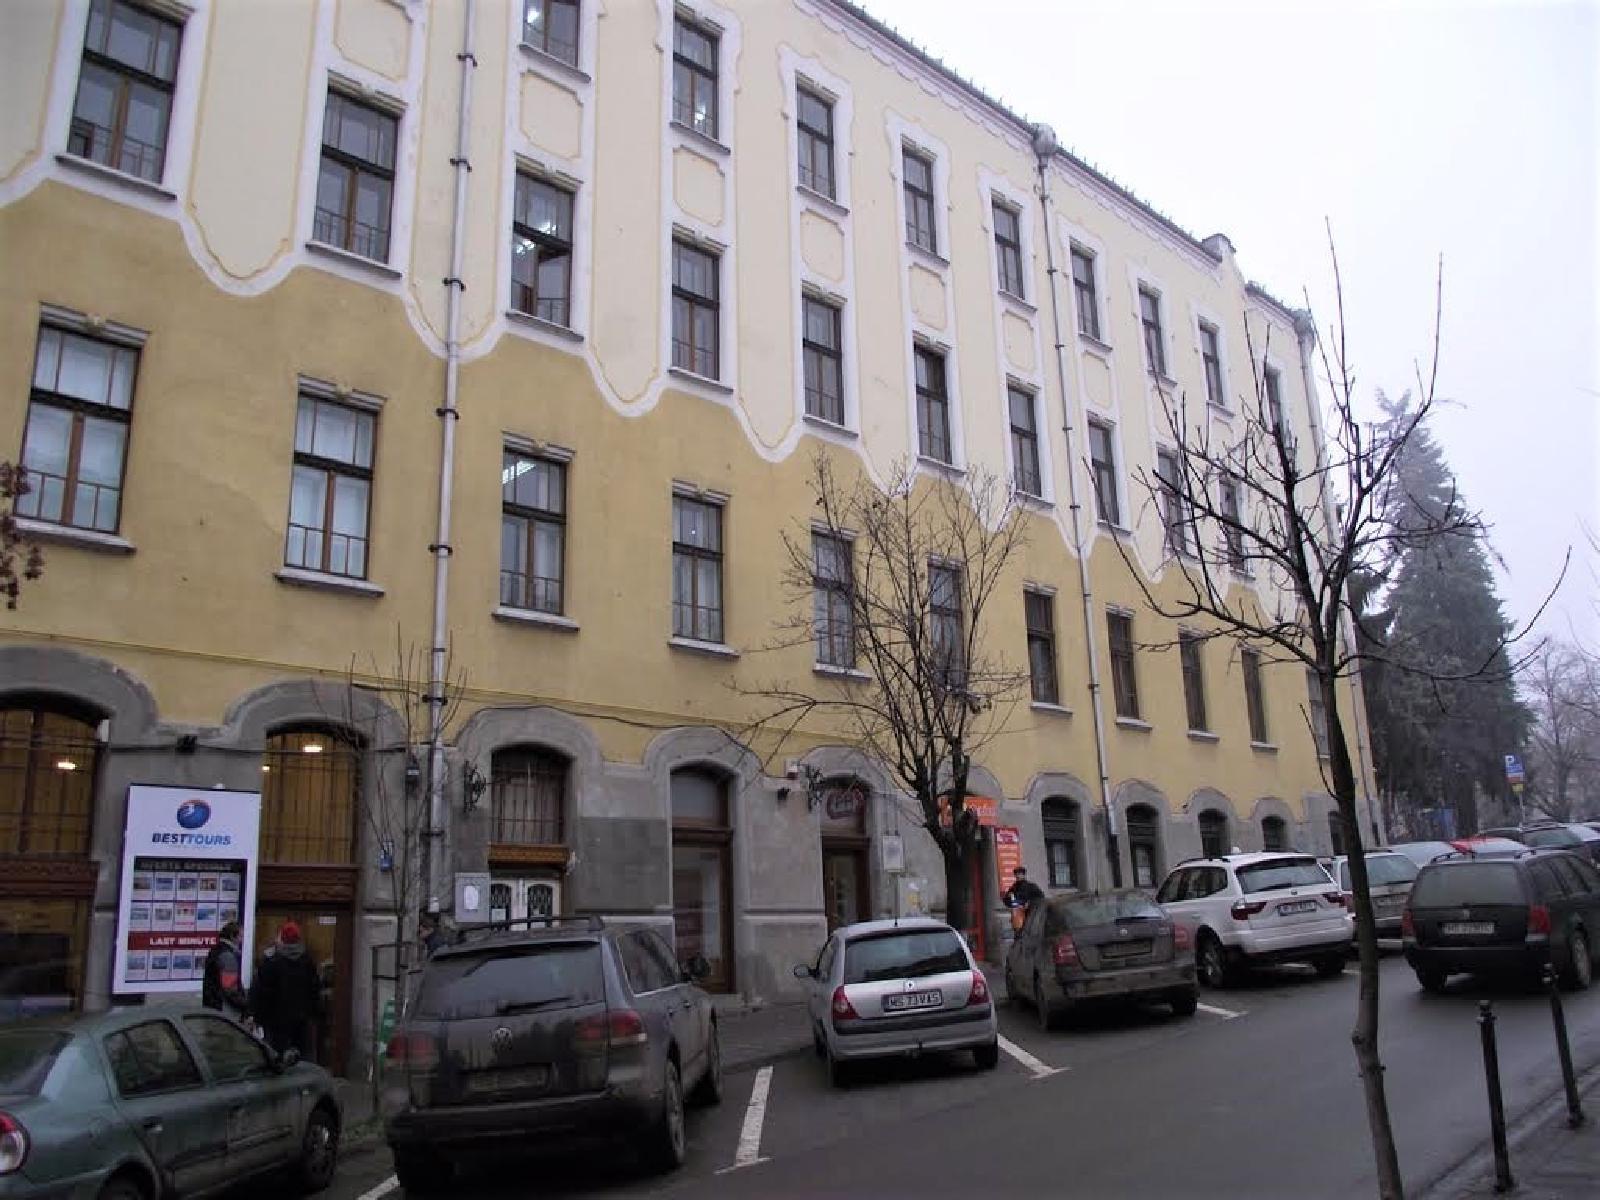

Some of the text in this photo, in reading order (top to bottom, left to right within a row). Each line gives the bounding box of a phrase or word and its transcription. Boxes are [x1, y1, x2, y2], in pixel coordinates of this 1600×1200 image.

[152, 832, 231, 845] BESTTOURS
[149, 937, 217, 945] LAST MINUTE
